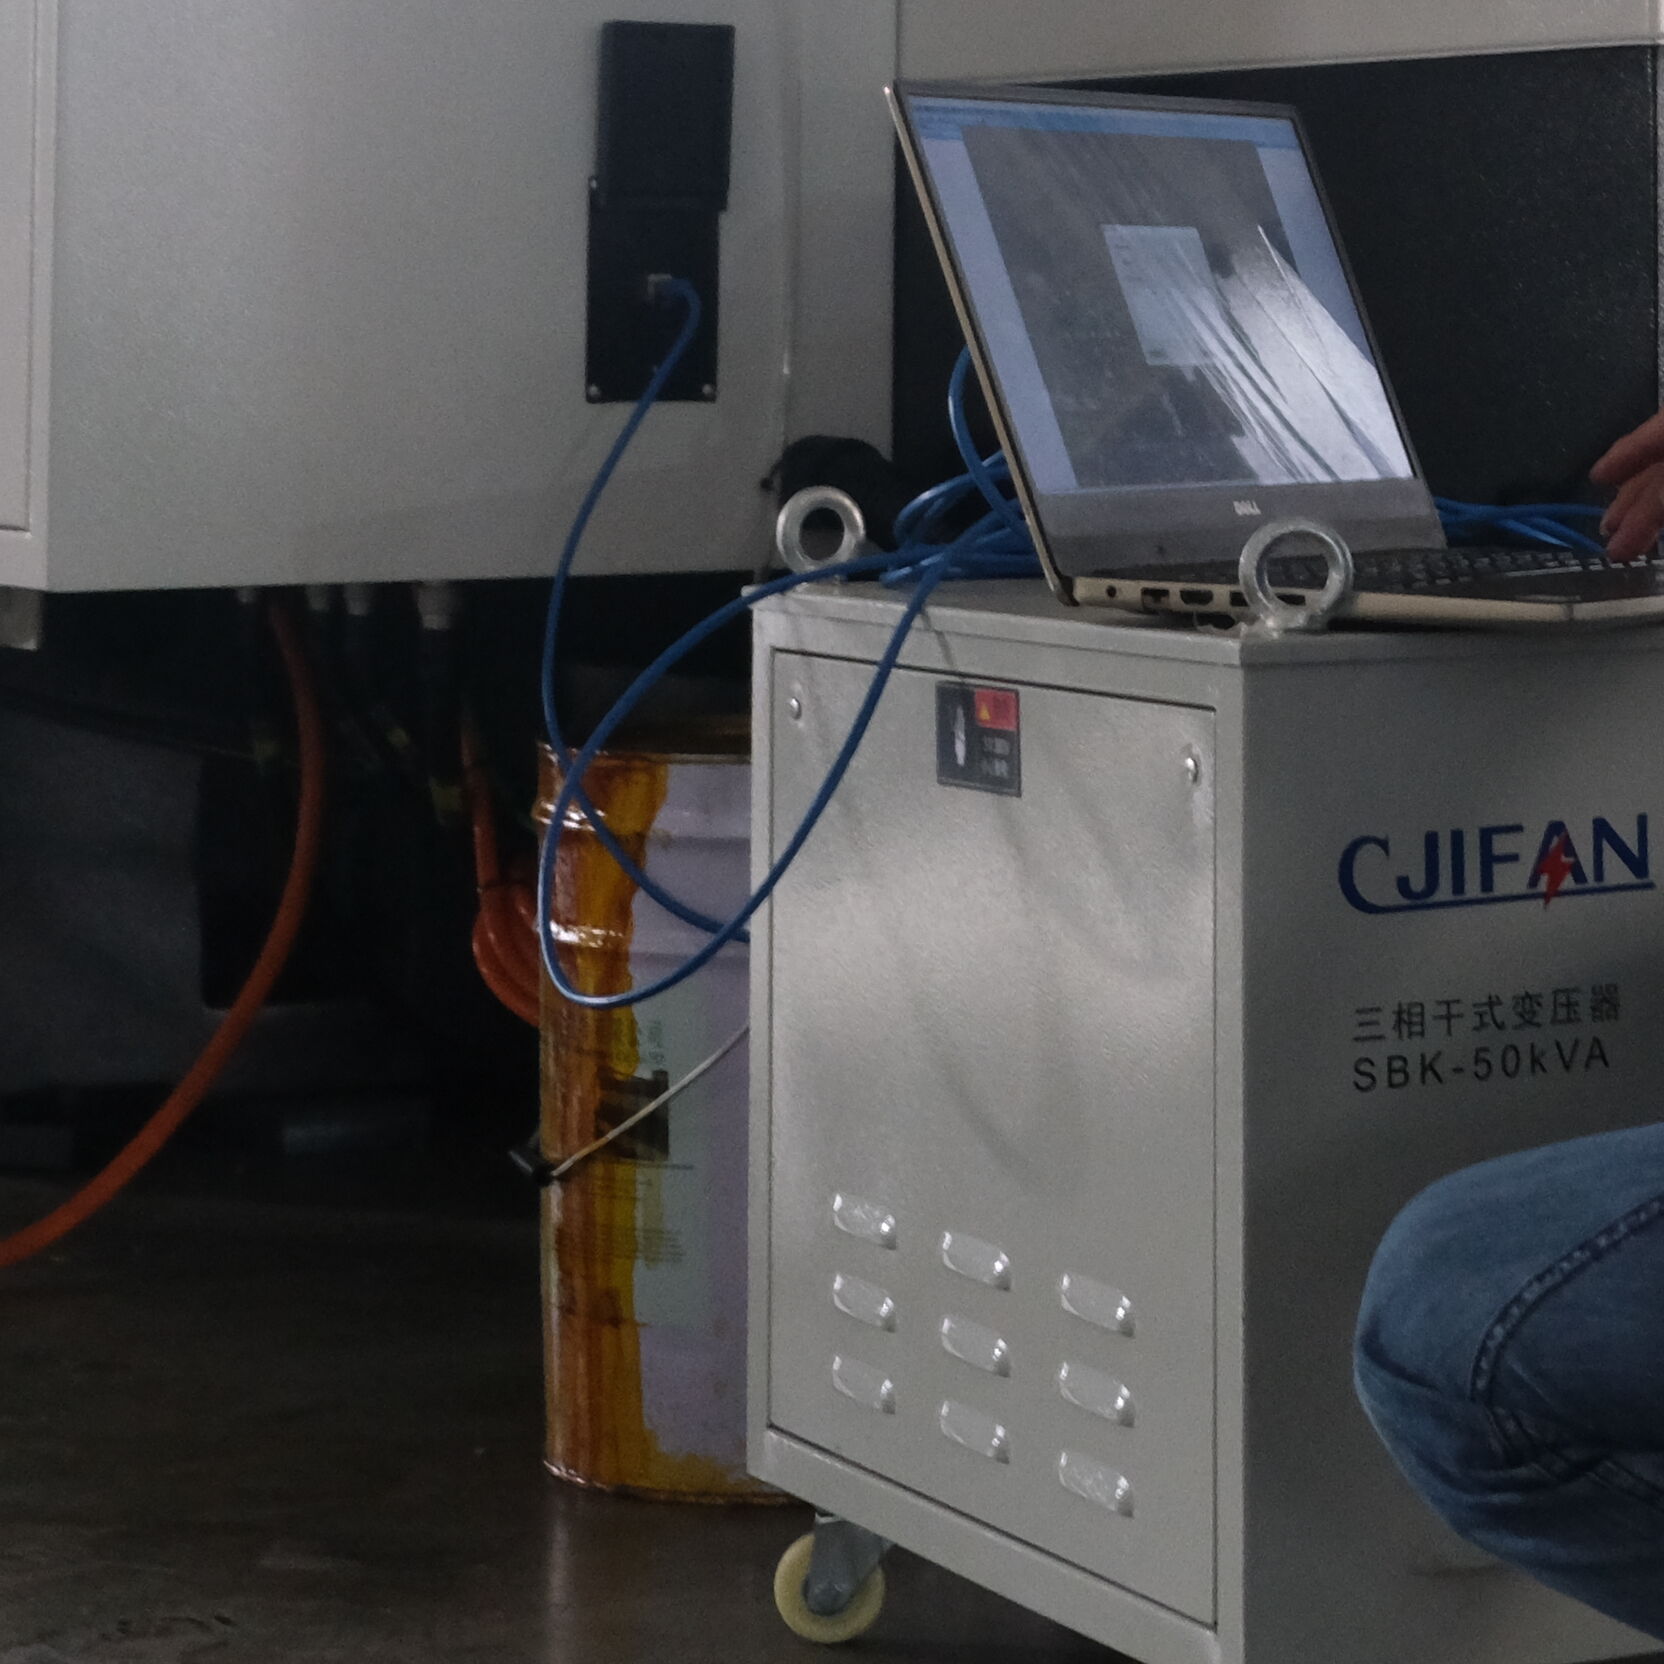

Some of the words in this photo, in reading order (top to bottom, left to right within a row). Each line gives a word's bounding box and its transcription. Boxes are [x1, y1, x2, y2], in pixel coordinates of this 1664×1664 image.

[1338, 812, 1655, 914] CJIFAN
[1353, 982, 1621, 1042] 三相干式变压器
[1353, 1035, 1610, 1093] SBK-50kVA
